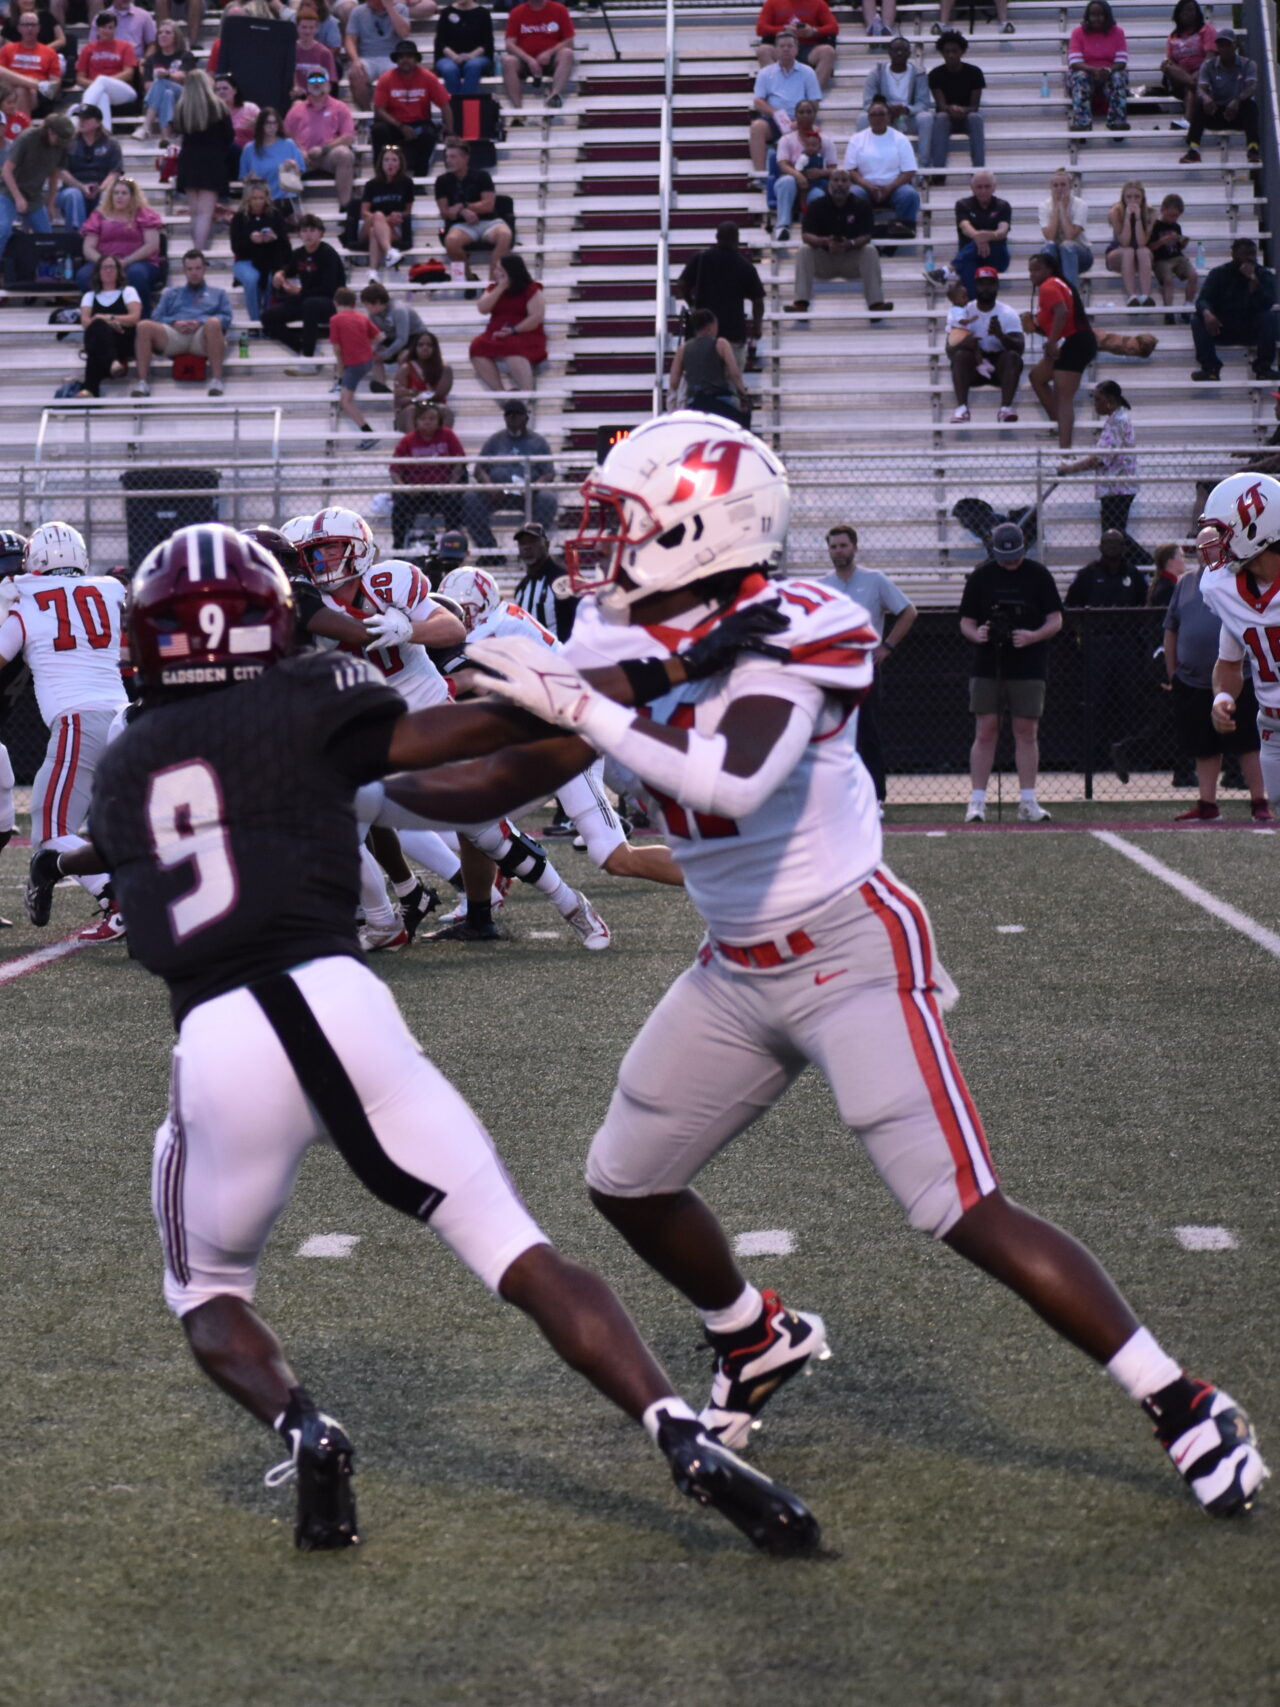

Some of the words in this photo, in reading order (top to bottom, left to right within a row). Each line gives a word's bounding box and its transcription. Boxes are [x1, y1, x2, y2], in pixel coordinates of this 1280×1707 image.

[371, 571, 393, 604] 20
[33, 586, 112, 652] 70
[198, 603, 225, 649] 9
[162, 667, 227, 685] GADSDEN
[233, 665, 264, 681] CITY
[147, 757, 239, 944] 9
